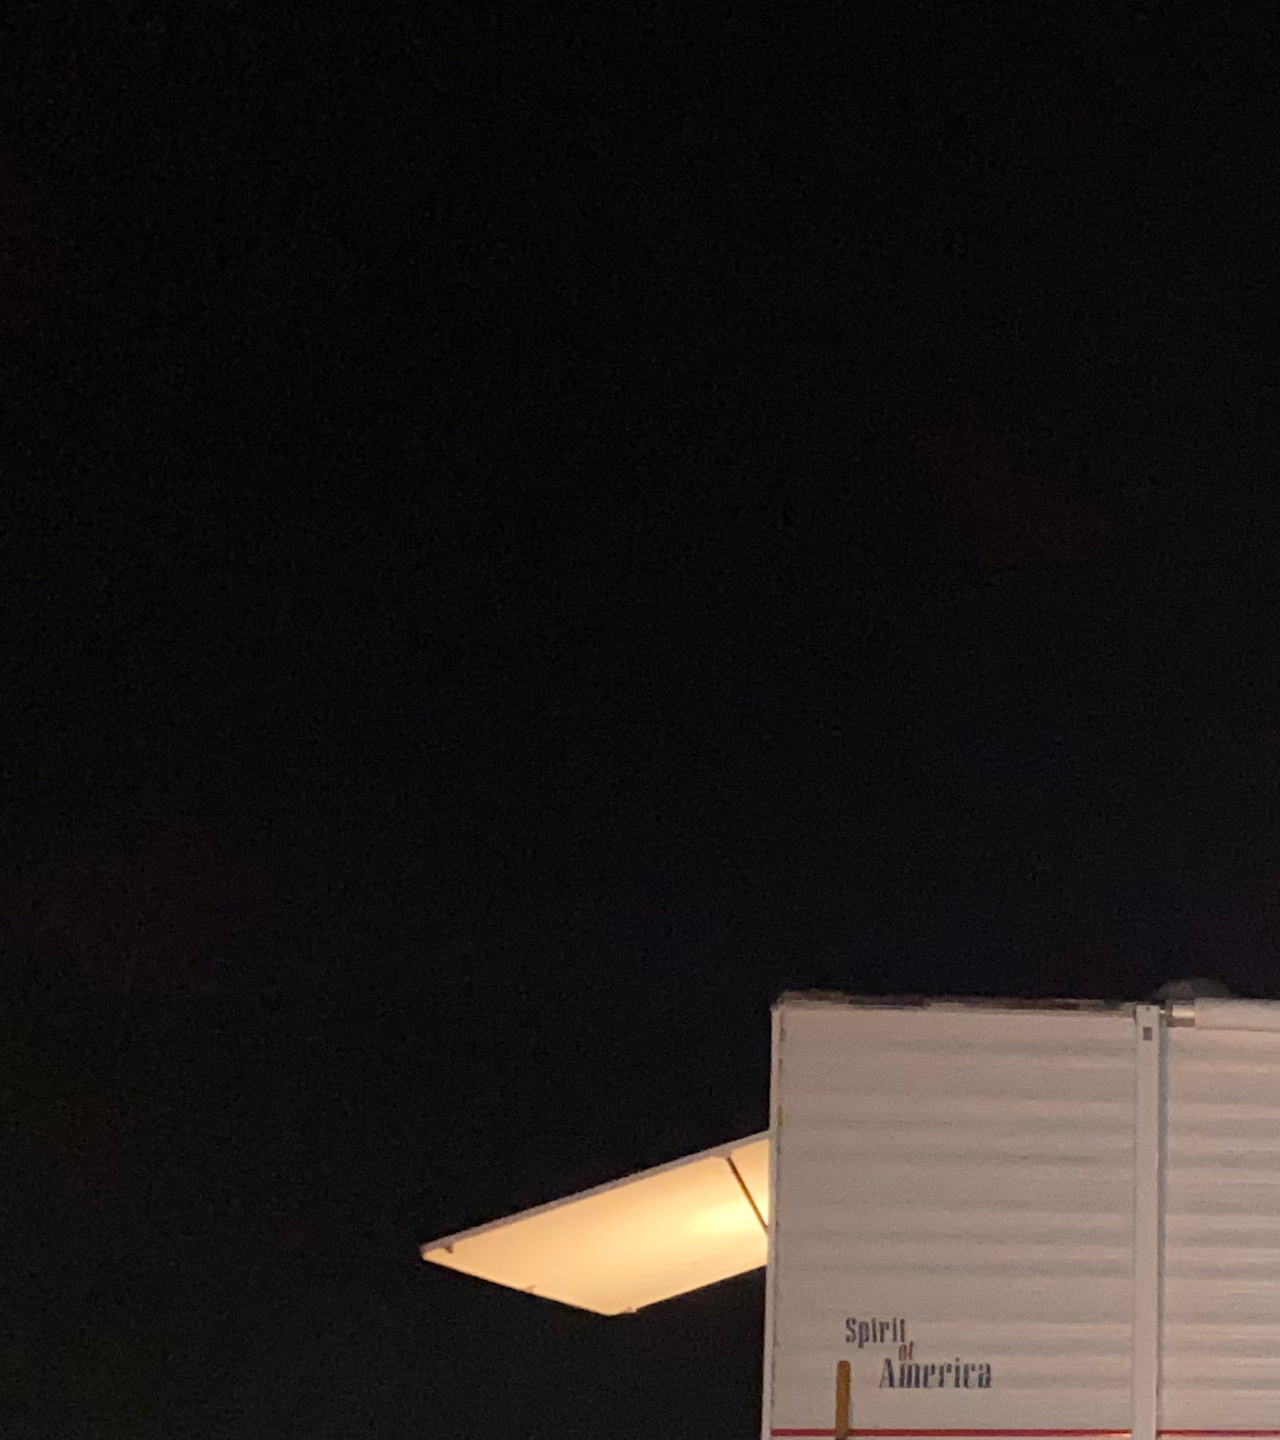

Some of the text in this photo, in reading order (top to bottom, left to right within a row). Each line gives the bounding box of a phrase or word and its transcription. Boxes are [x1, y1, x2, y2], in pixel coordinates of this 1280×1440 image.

[845, 1317, 905, 1349] Spirit
[898, 1341, 914, 1361] of
[879, 1357, 990, 1389] America
